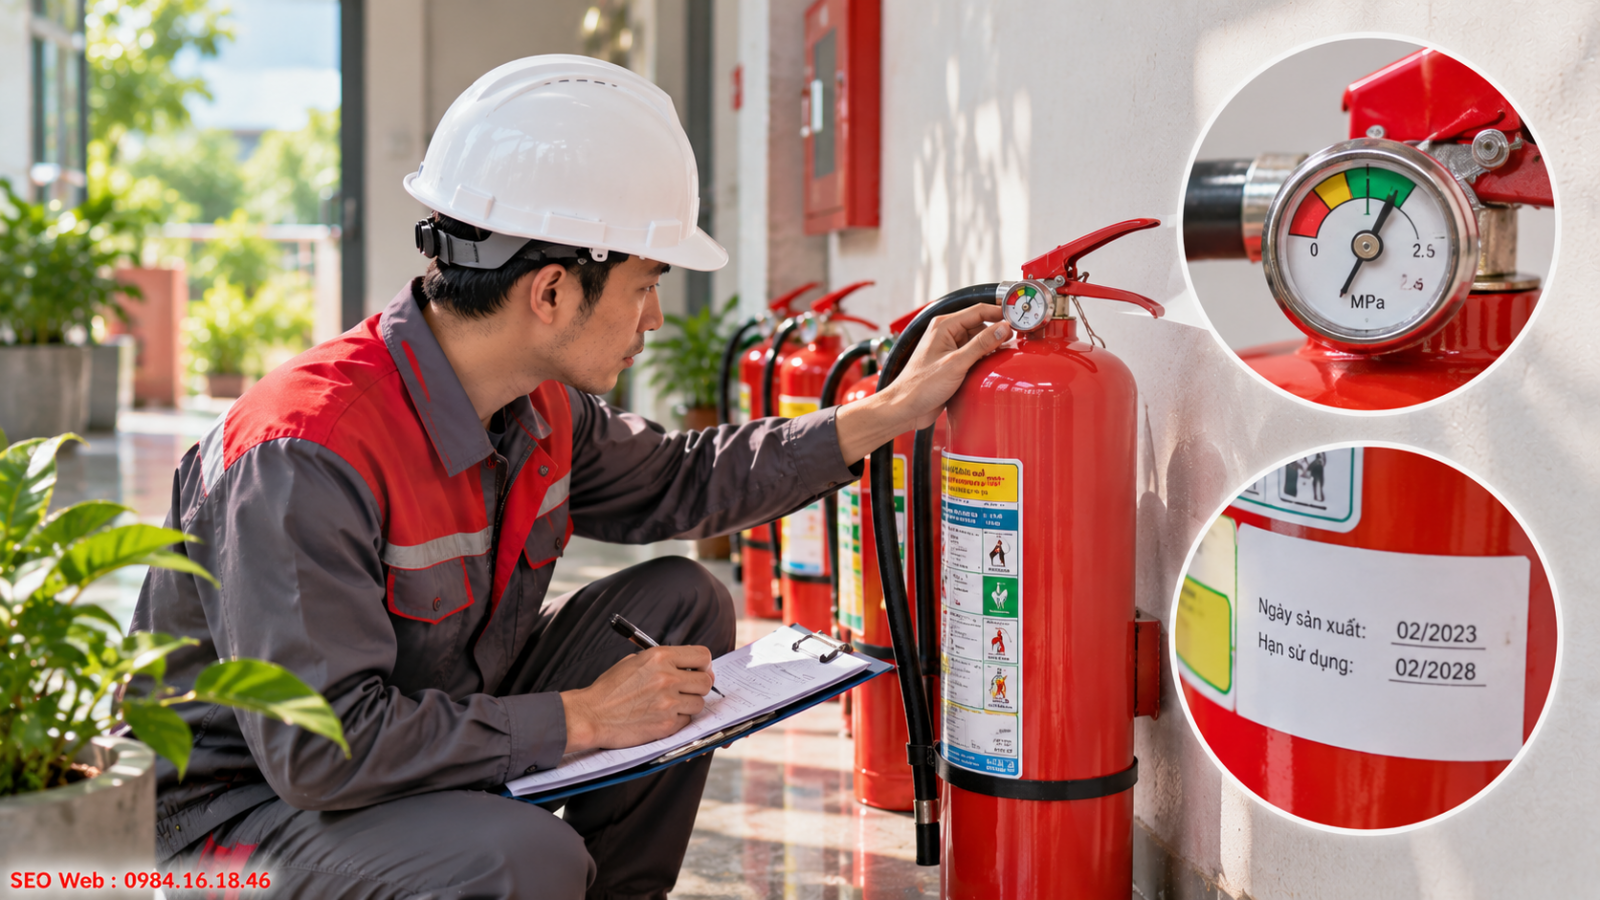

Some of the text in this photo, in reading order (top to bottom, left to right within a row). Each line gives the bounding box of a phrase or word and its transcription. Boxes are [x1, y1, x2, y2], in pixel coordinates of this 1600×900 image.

[1310, 242, 1319, 257] 0
[1412, 243, 1435, 258] 2.5
[1350, 295, 1385, 310] MPa
[1258, 597, 1292, 626] Ngày
[1326, 617, 1366, 639] xuất:
[1396, 621, 1477, 643] 02/2023
[1258, 631, 1284, 656] Hạn
[1309, 649, 1354, 676] dụng:
[1395, 658, 1476, 681] 02/2028
